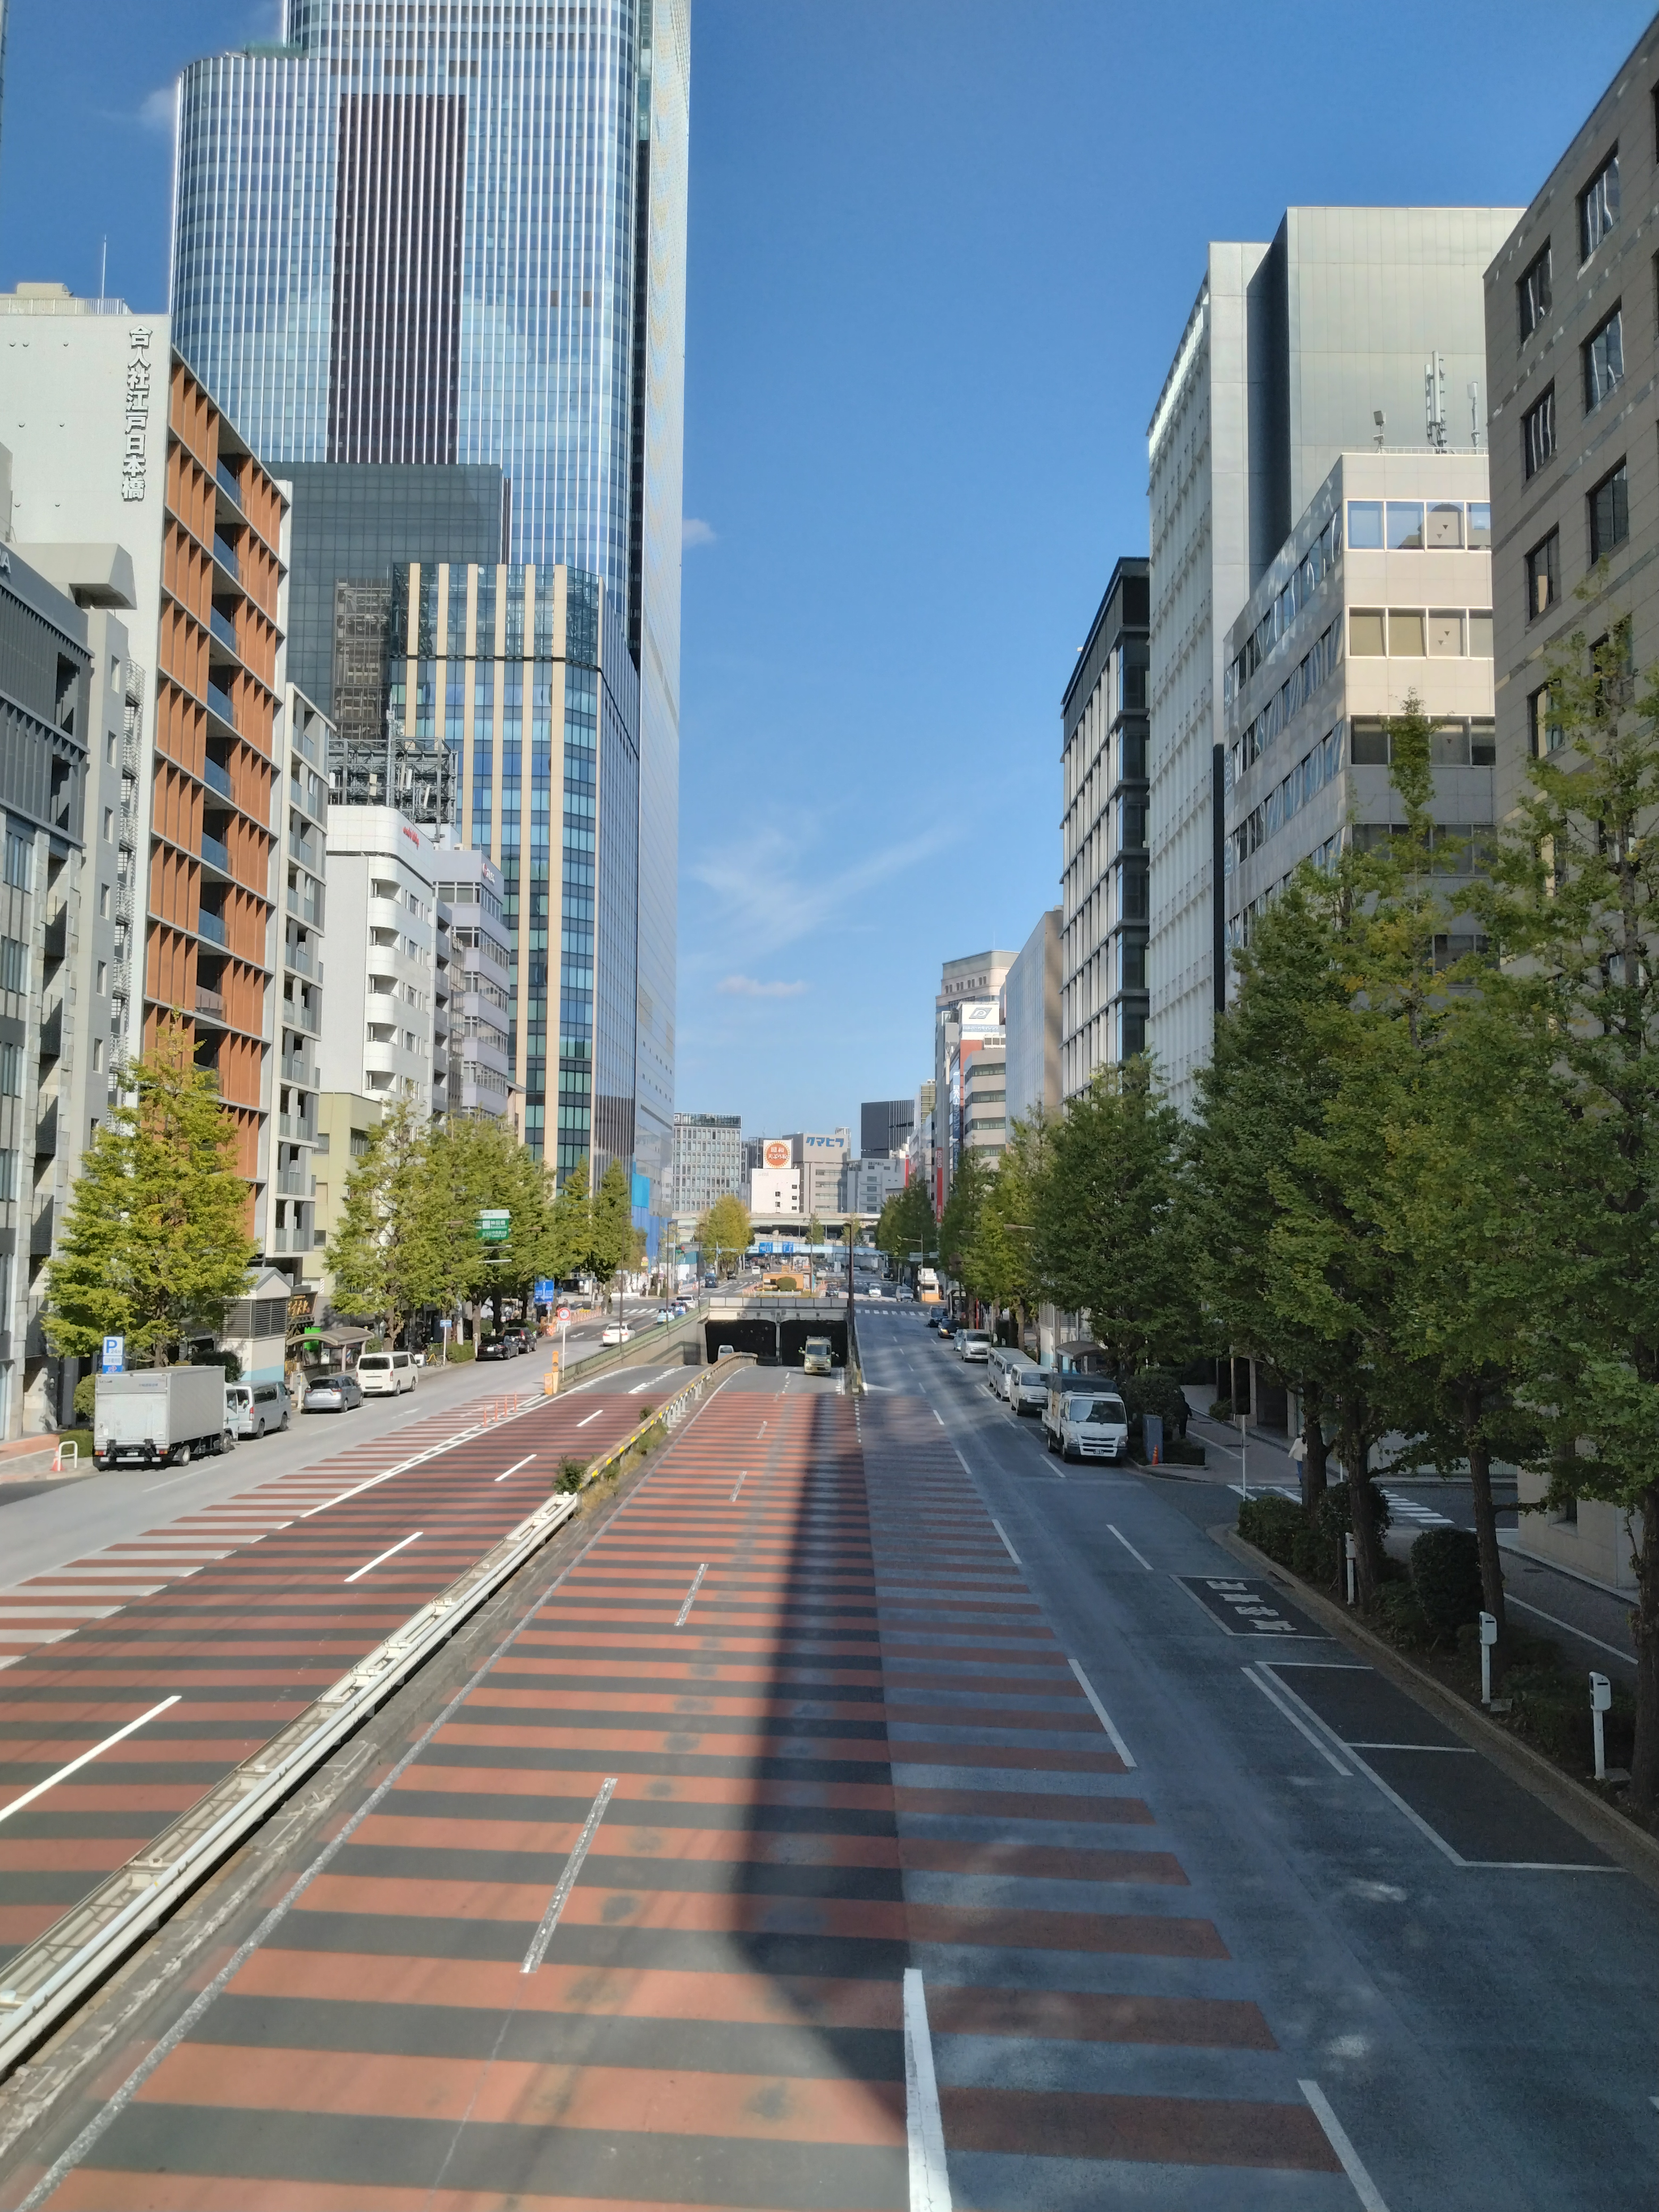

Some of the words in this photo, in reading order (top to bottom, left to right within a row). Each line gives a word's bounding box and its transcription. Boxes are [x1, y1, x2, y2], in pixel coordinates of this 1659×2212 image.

[122, 324, 153, 501] 合人社江戸日本橋
[0, 548, 11, 574] A
[806, 1136, 844, 1147] クマヒラ
[106, 1339, 118, 1353] P
